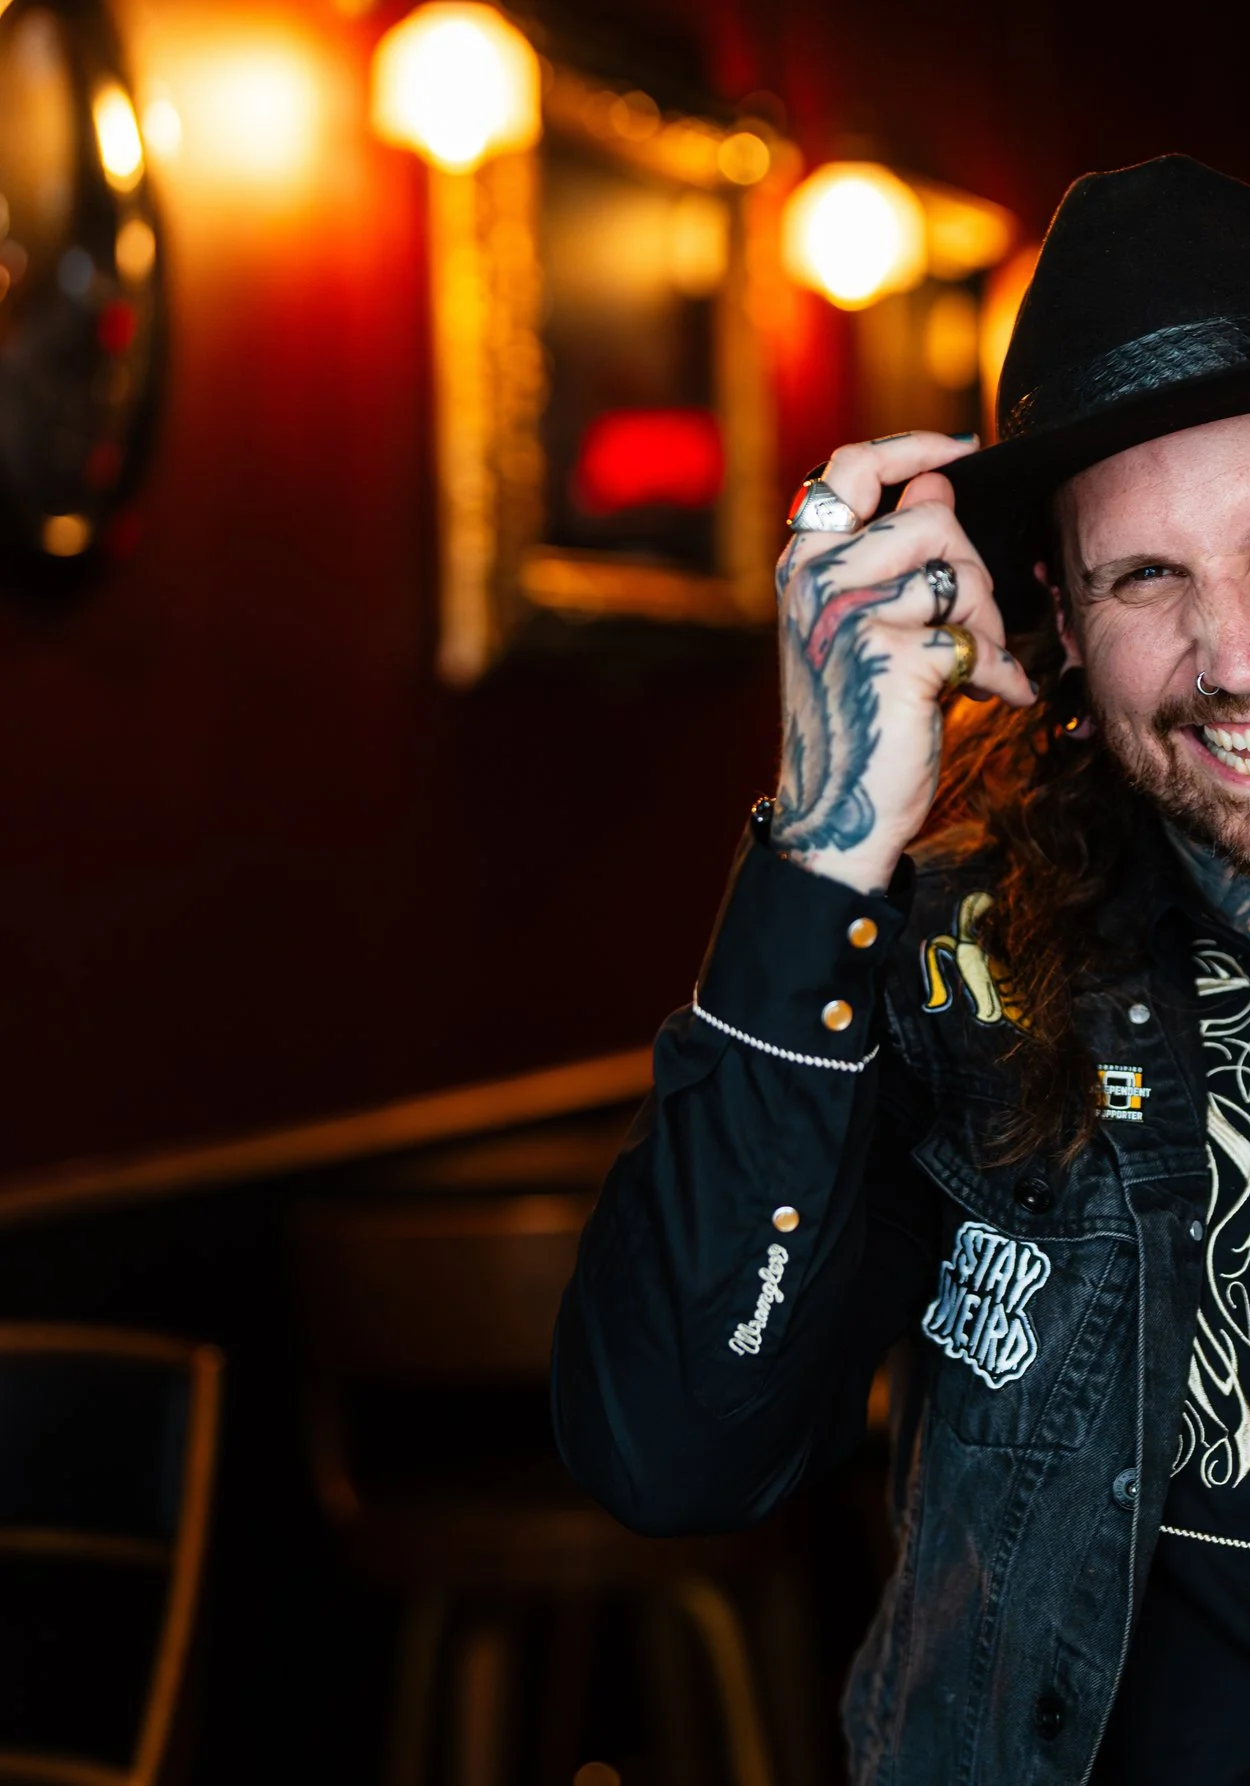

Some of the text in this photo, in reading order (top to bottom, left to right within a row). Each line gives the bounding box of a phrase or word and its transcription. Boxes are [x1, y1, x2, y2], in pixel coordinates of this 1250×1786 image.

[1094, 1085, 1151, 1097] EPENDENT
[728, 1243, 789, 1357] Wrangler
[957, 1229, 1042, 1314] STAY
[929, 1272, 1029, 1374] WEIRD
